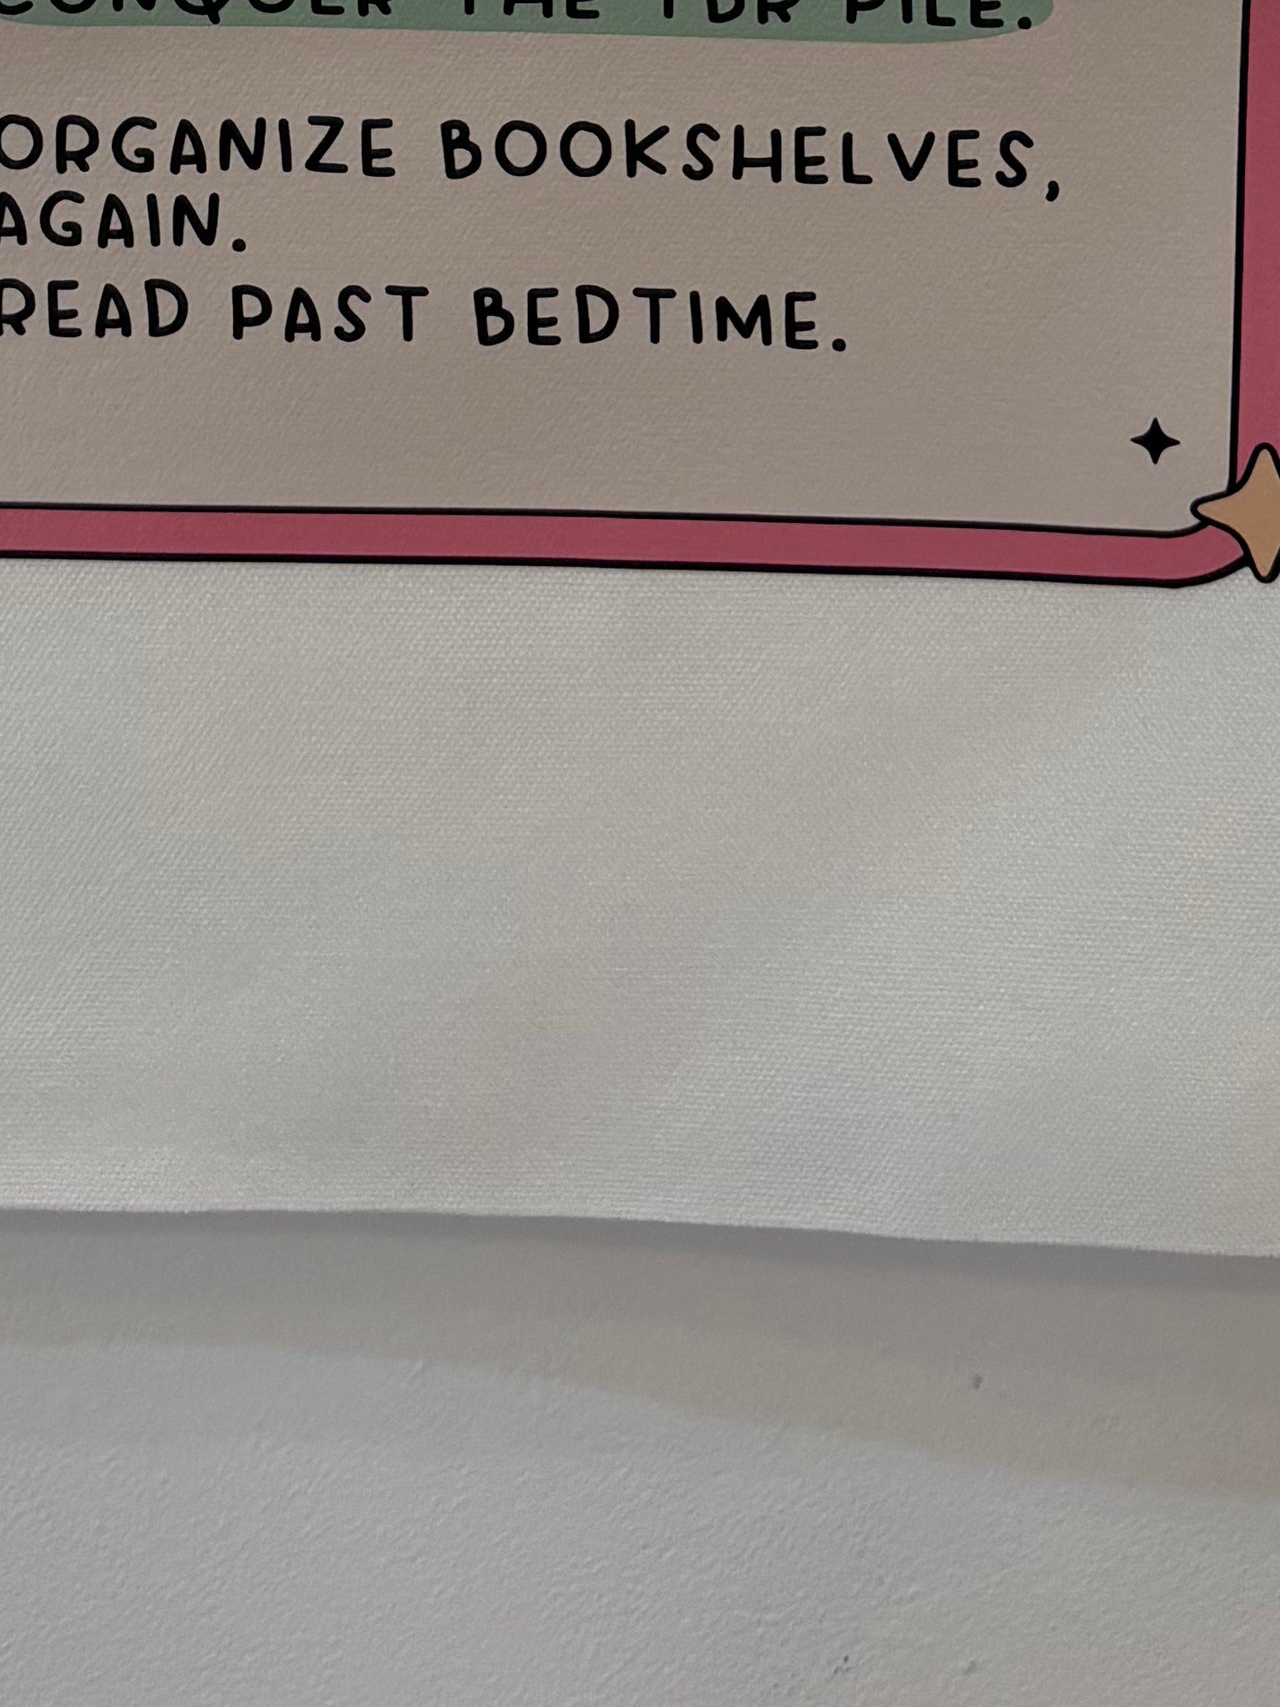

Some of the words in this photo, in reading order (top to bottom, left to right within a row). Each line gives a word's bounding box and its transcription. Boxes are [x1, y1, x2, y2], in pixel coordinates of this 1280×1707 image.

[439, 117, 1061, 203] BOOKSHELVES,
[230, 283, 430, 344] PAST
[472, 283, 848, 353] BEDTIME.
